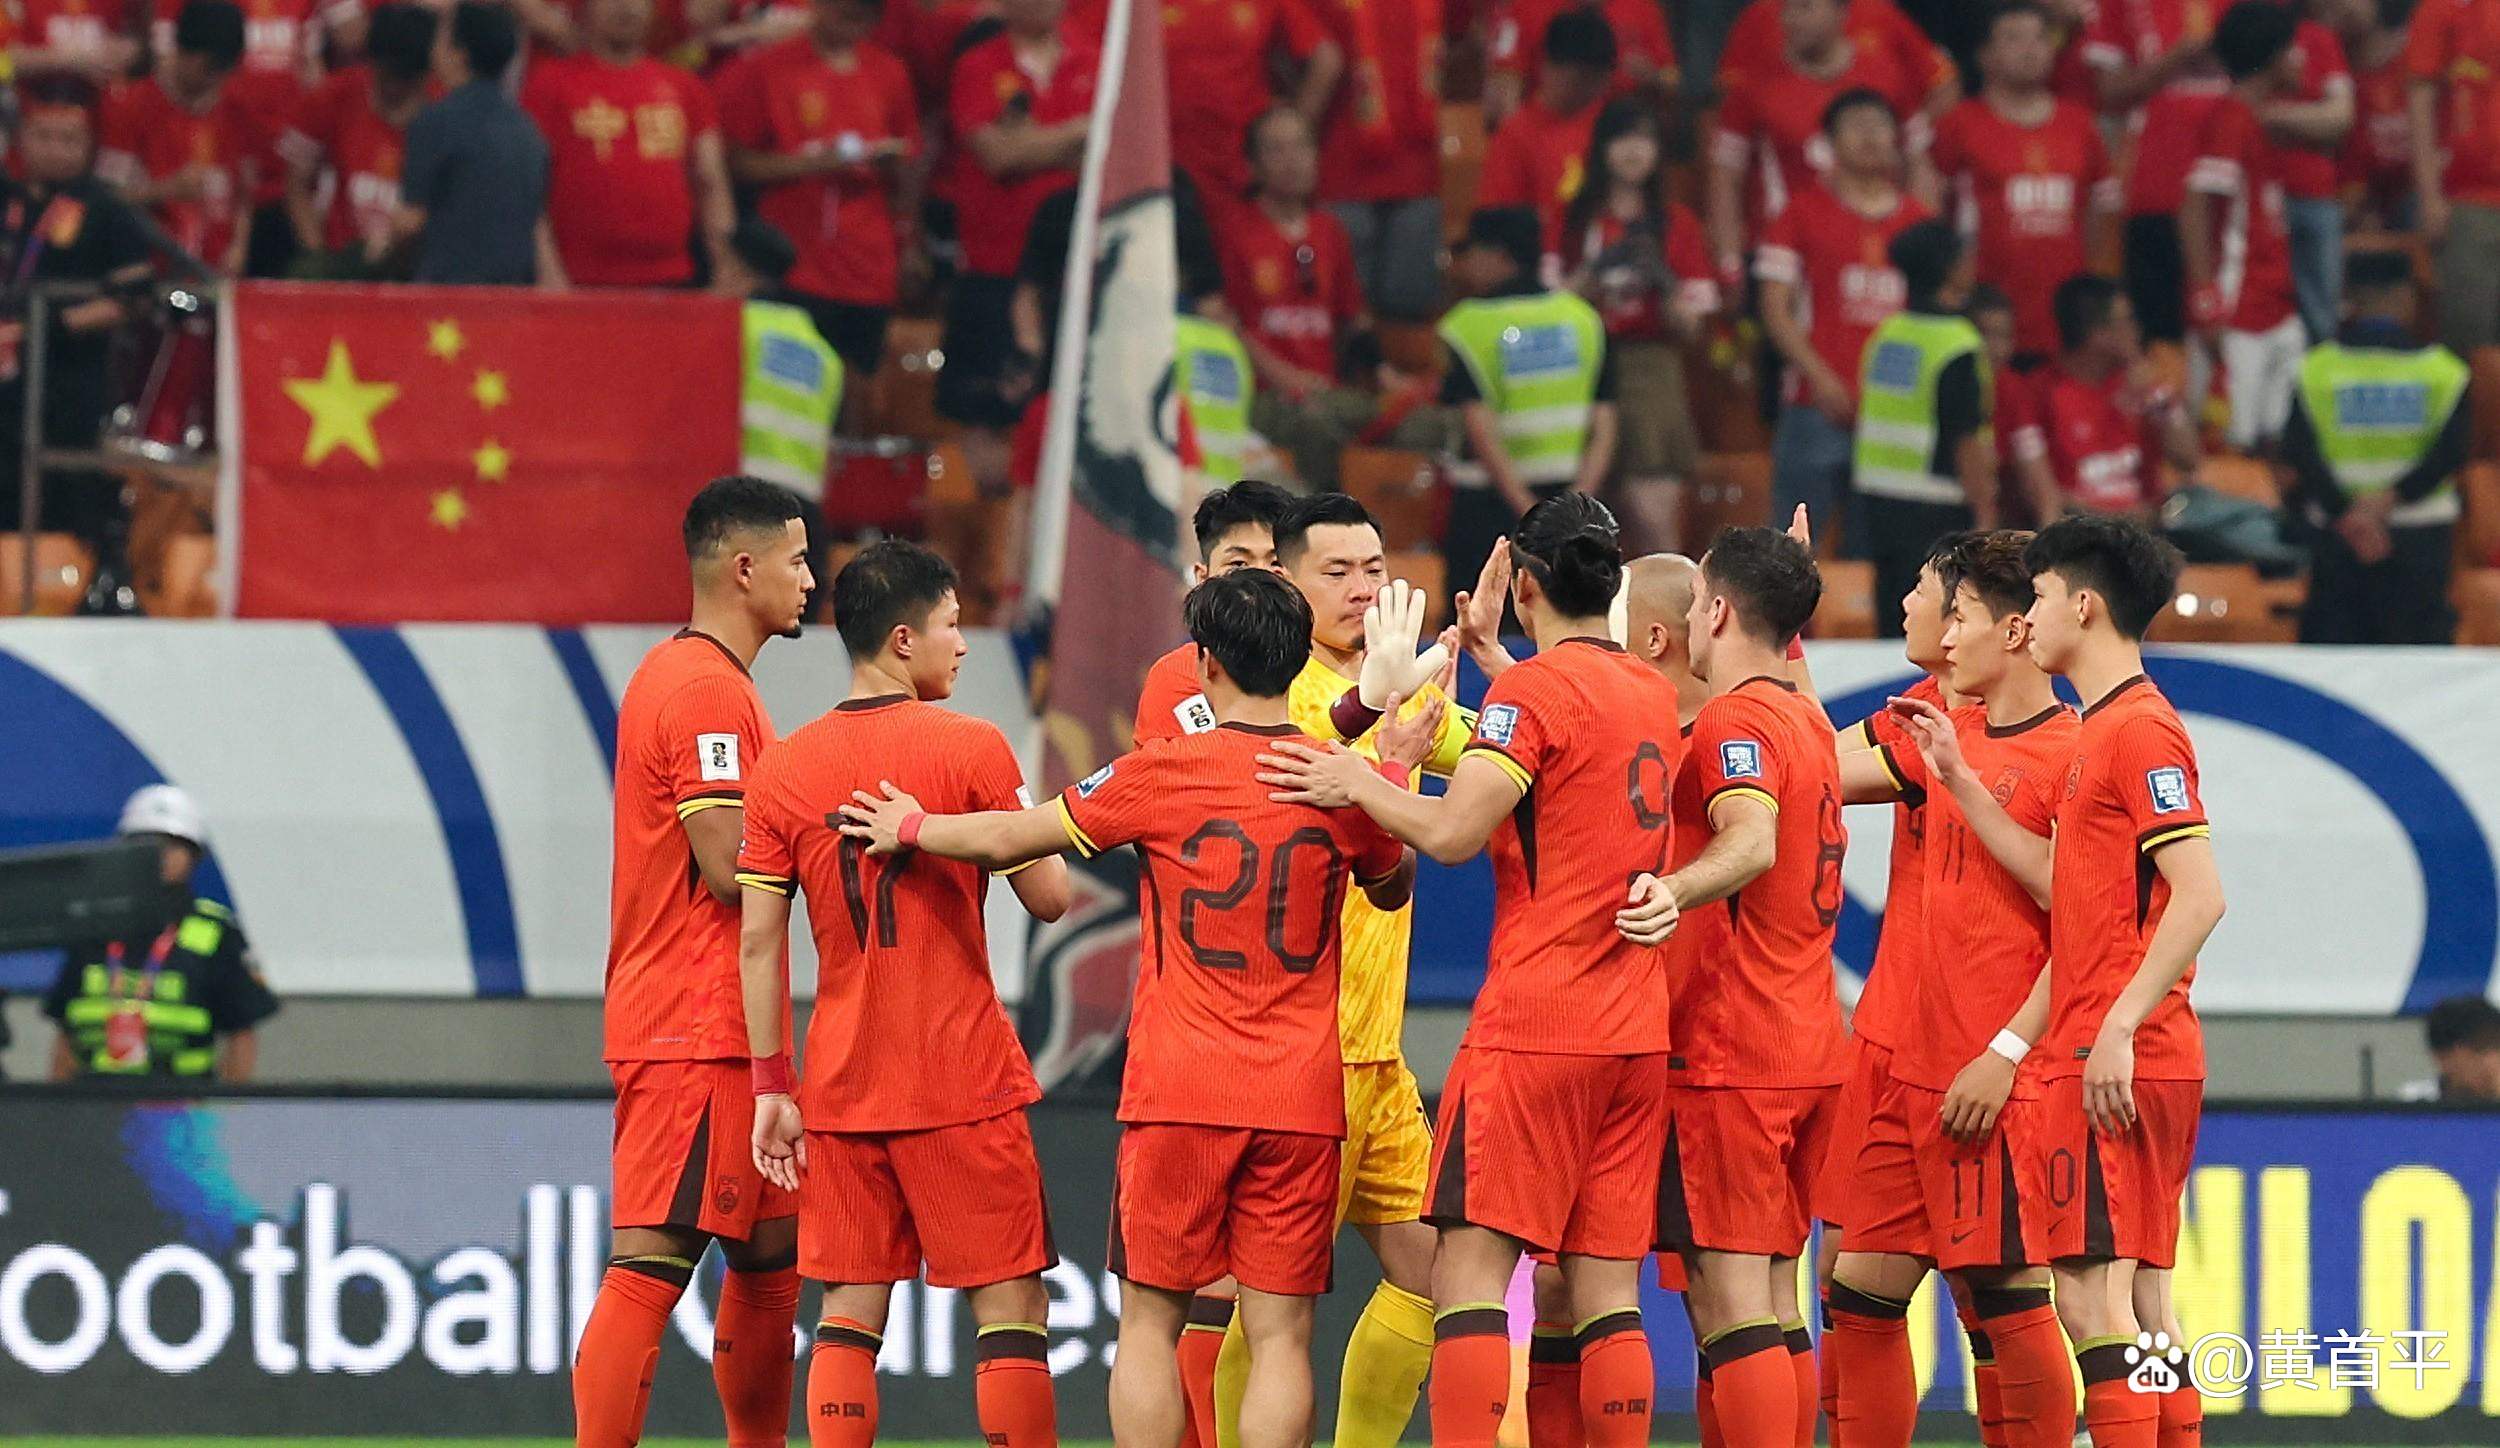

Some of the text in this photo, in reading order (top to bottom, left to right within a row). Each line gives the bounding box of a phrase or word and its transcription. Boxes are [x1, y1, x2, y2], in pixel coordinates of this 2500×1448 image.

[1627, 741, 1669, 886] 9
[1812, 783, 1846, 927] 8
[1942, 822, 1965, 884] 11
[1179, 819, 1343, 973] 20
[1951, 1158, 1984, 1219] 11
[0, 1183, 603, 1375] ootball
[820, 1402, 865, 1418] 中国
[1604, 1399, 1647, 1415] 中国
